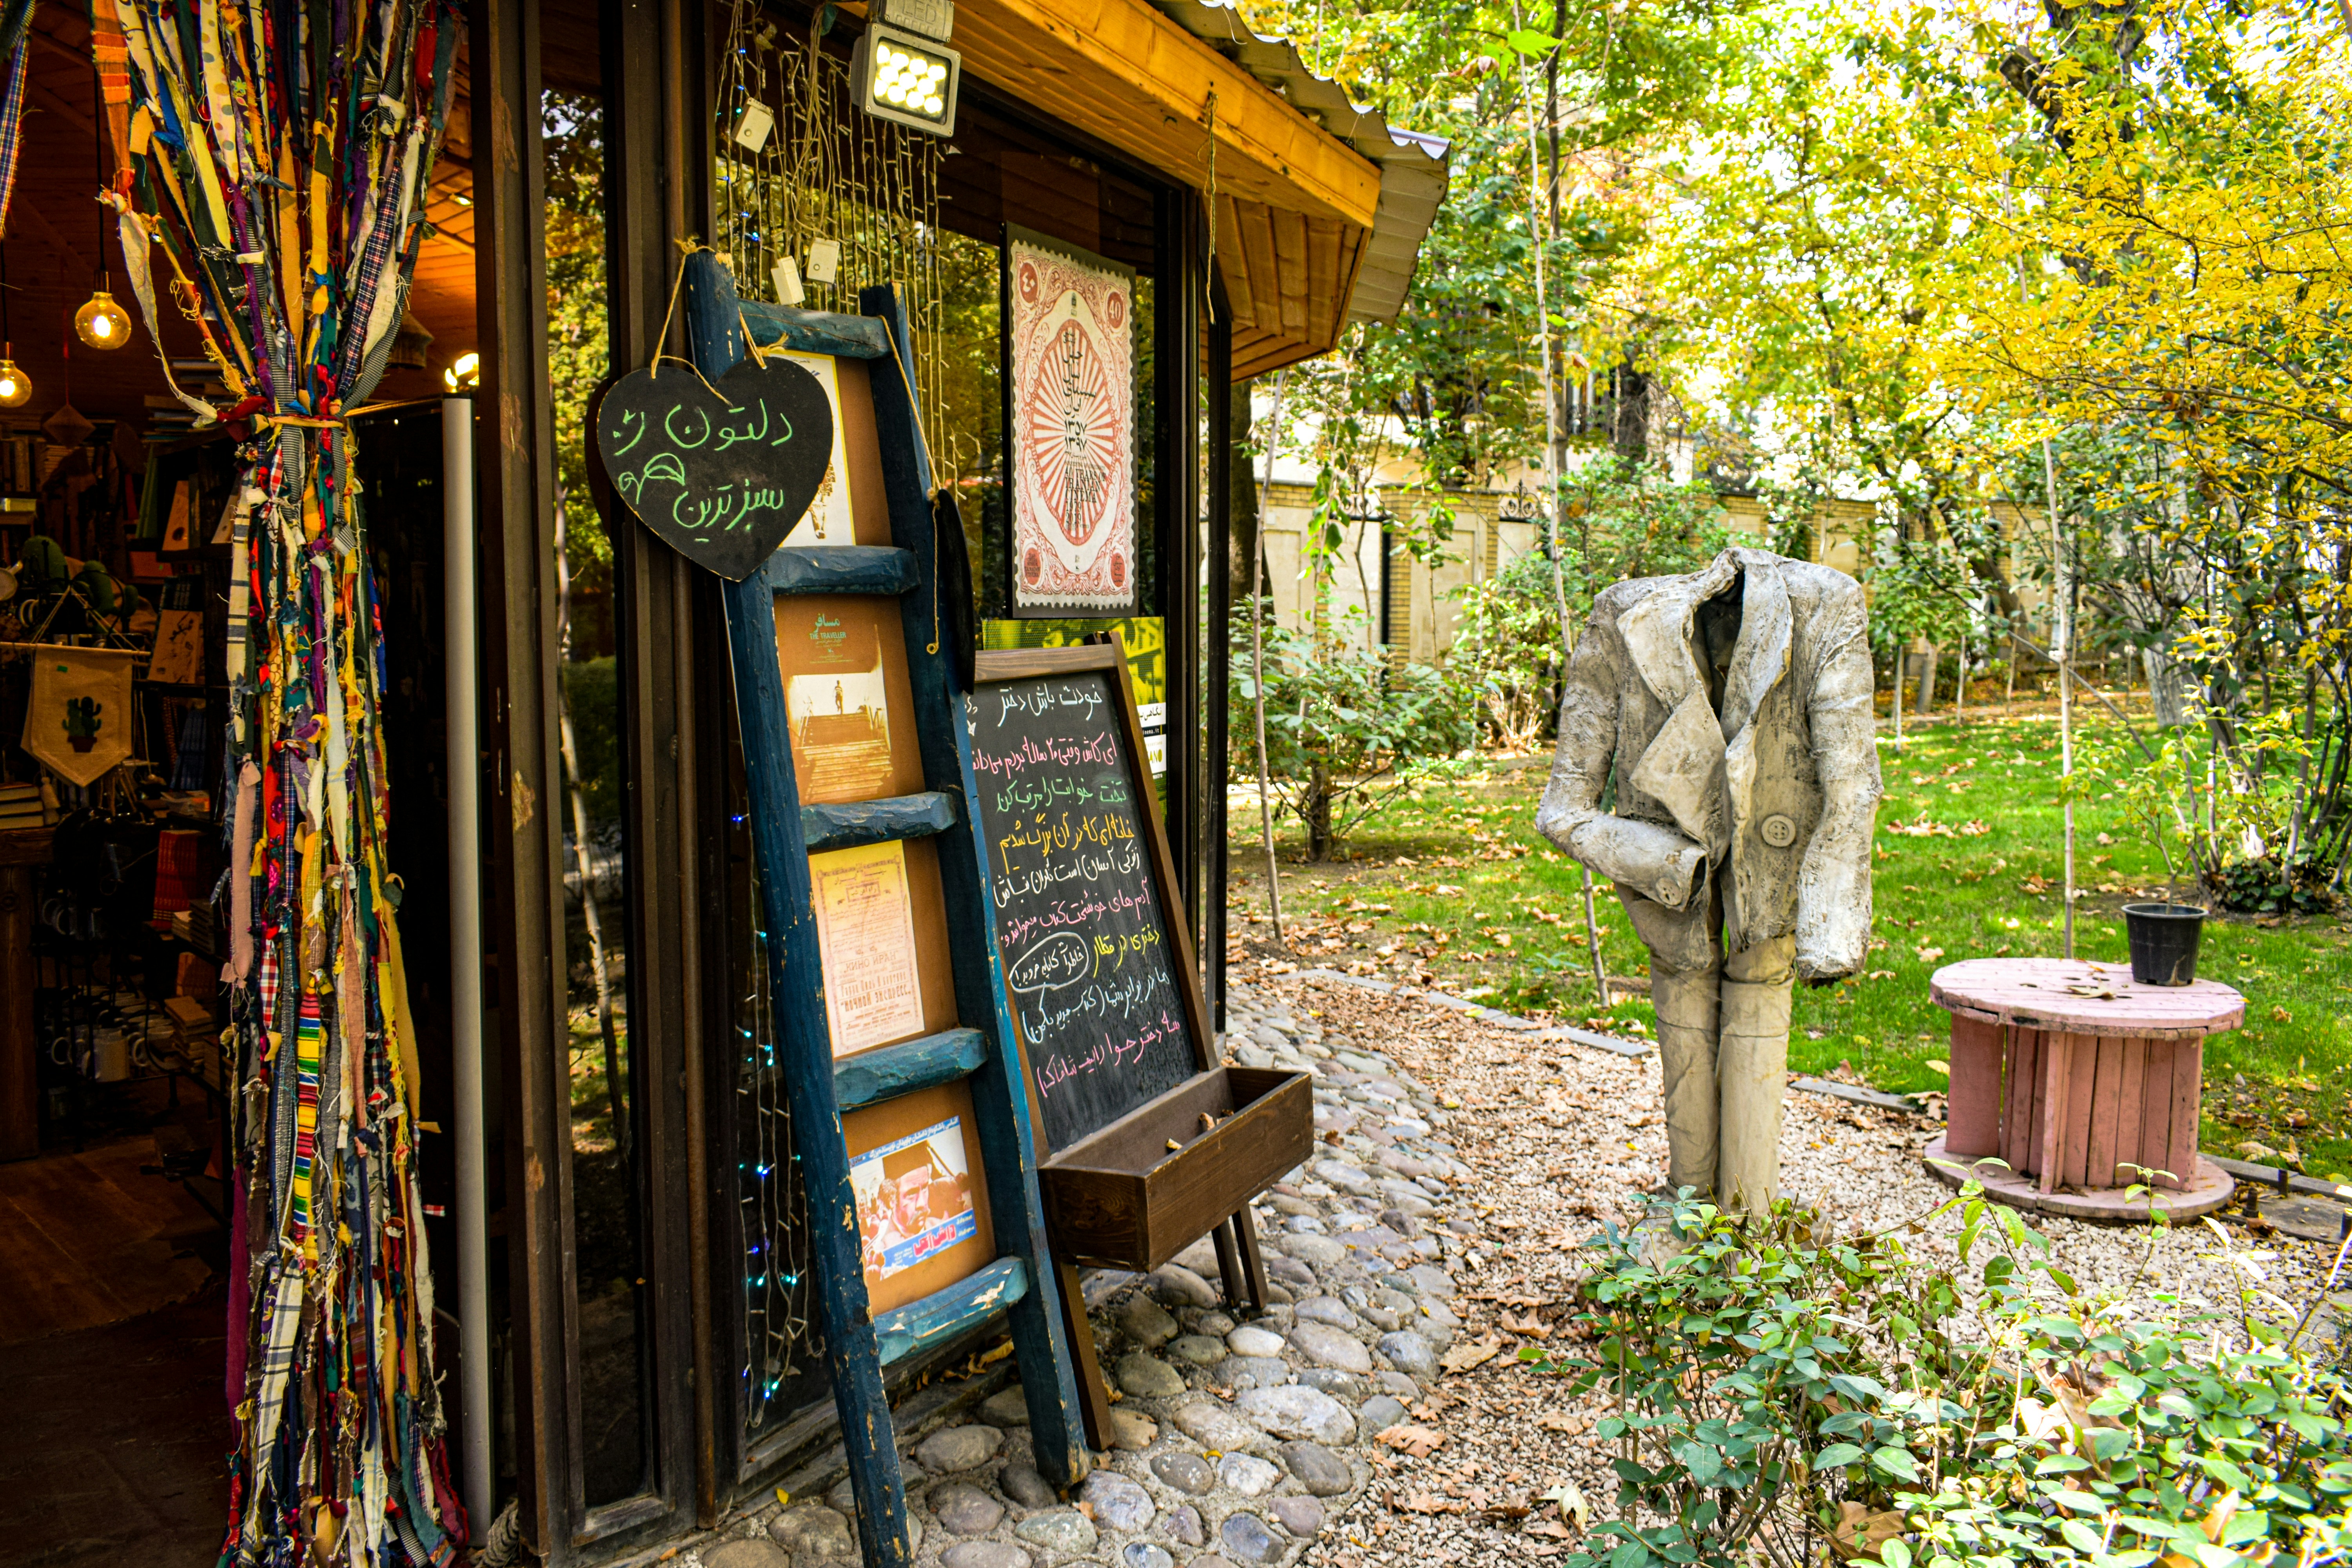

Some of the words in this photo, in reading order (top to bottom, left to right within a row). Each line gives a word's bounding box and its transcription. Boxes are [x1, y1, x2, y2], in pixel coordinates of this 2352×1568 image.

[1109, 299, 1121, 320] 40
[1065, 465, 1073, 476] 40
[1075, 468, 1097, 481] YEARS
[1099, 471, 1107, 481] OF
[1065, 477, 1100, 492] IRANIAN
[1065, 490, 1097, 503] CINEMA
[813, 613, 840, 633] مسافر
[820, 631, 846, 639] TRAVELLER
[997, 686, 1026, 727] دختر
[1027, 682, 1055, 717] باش
[1059, 683, 1102, 721] خودت
